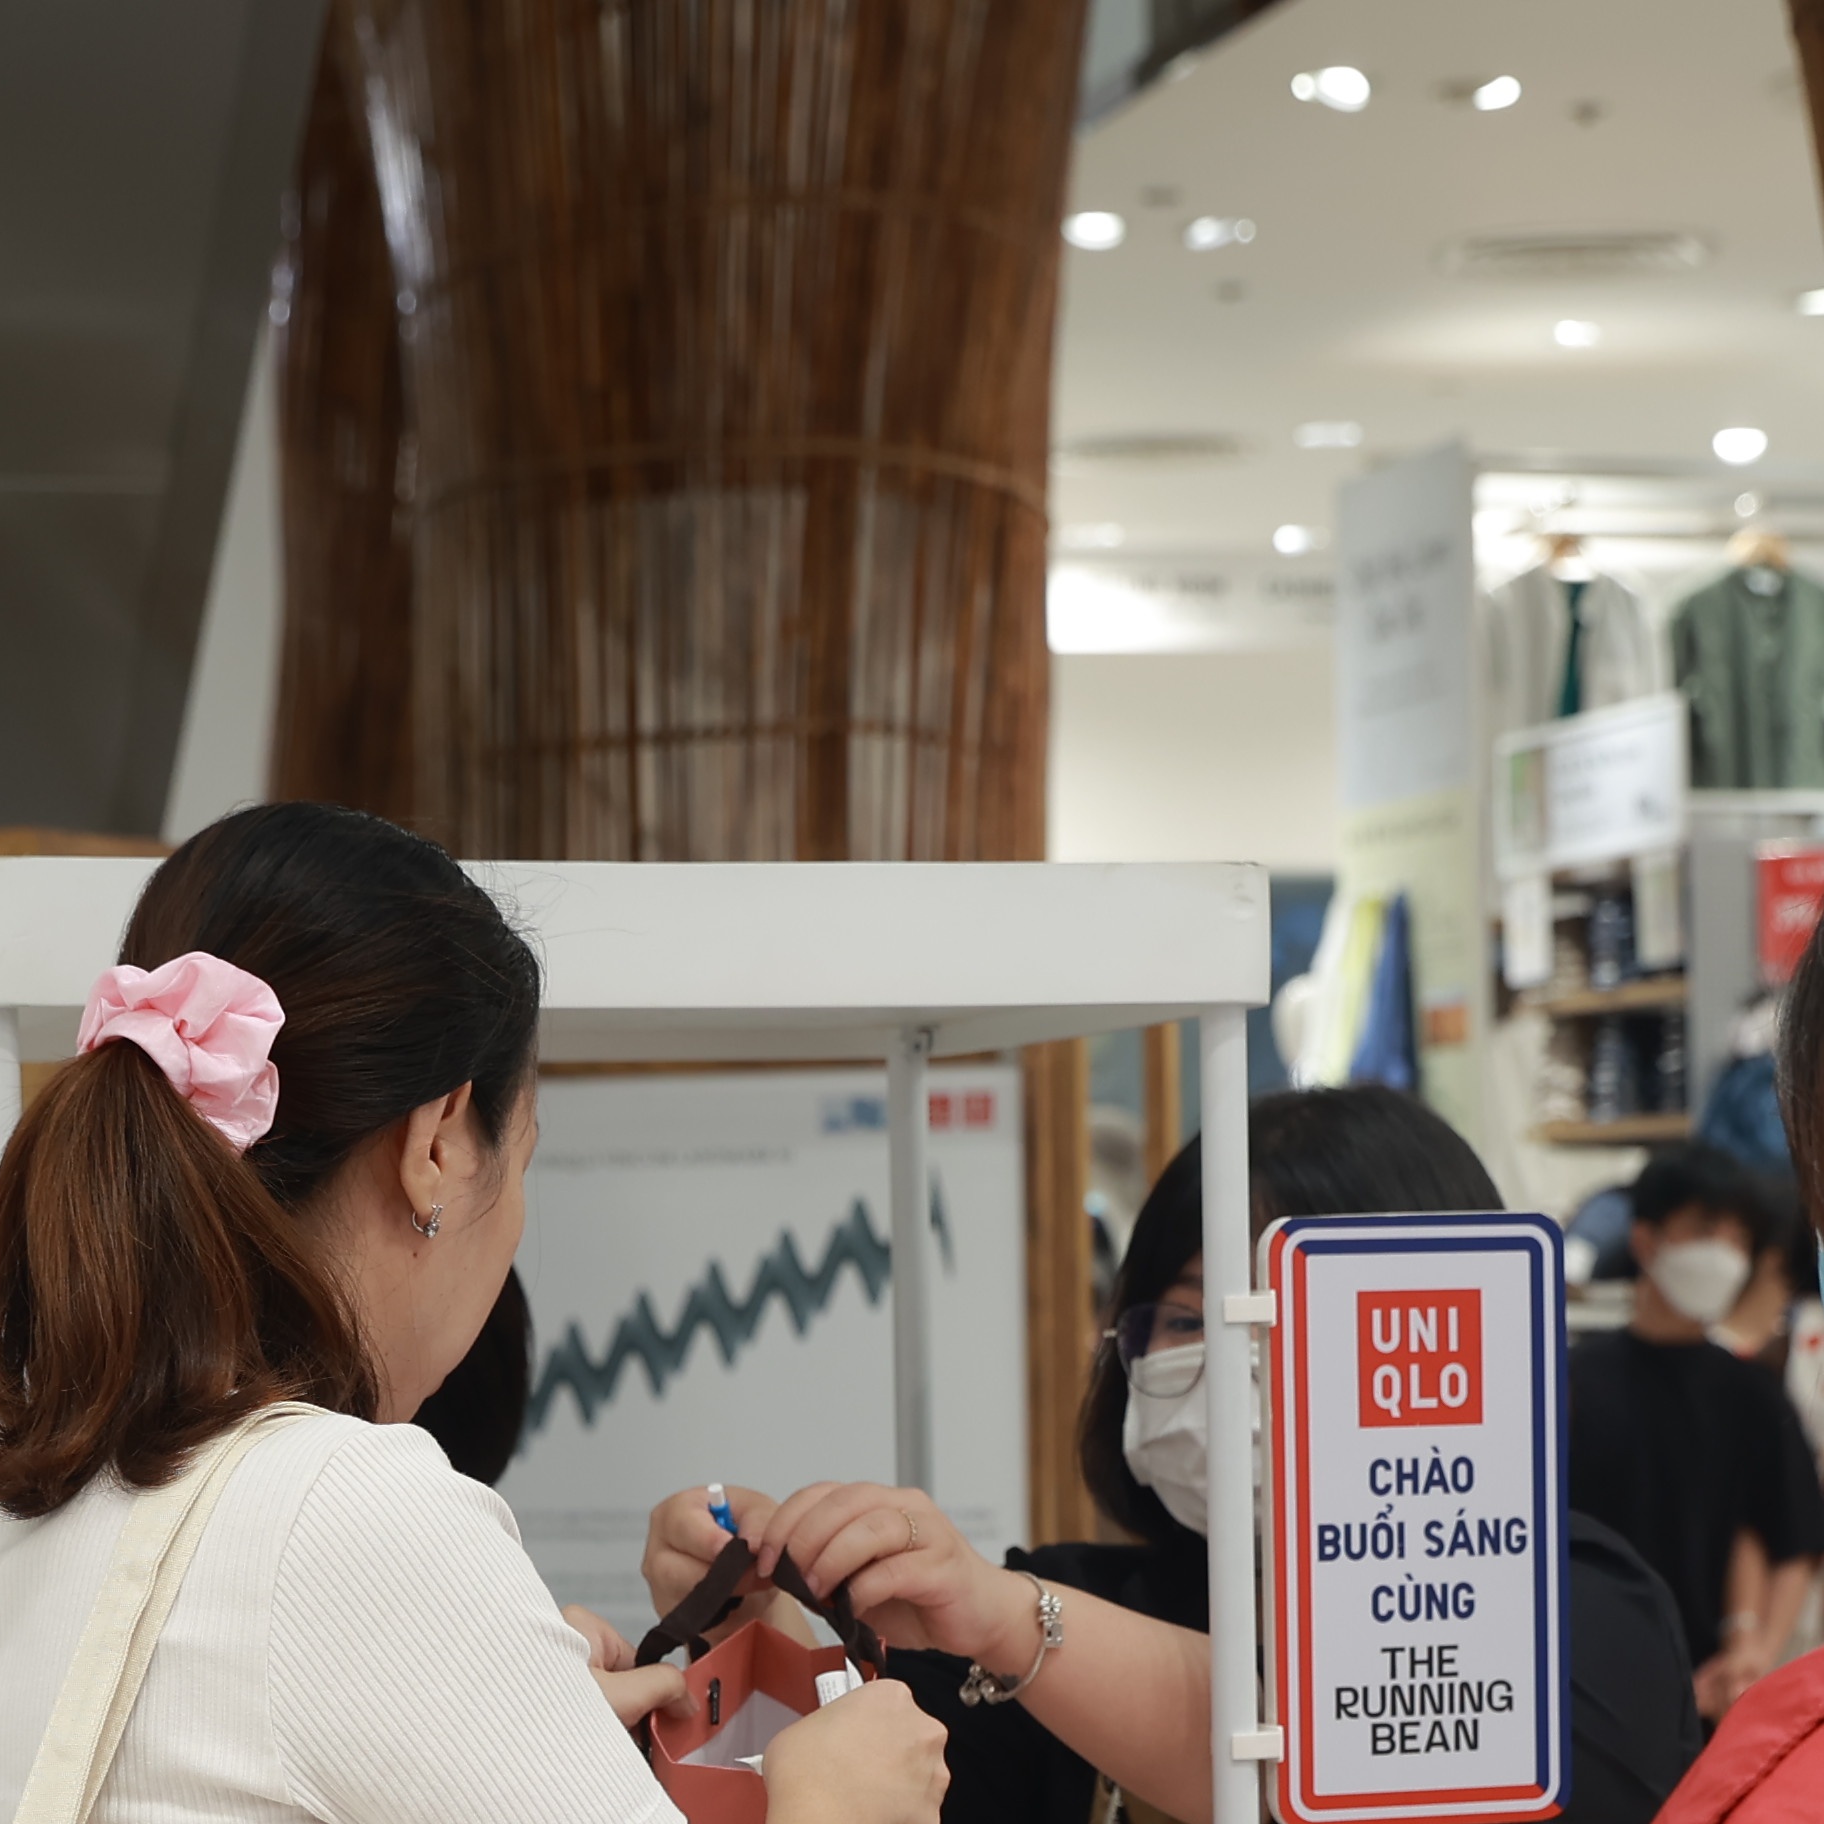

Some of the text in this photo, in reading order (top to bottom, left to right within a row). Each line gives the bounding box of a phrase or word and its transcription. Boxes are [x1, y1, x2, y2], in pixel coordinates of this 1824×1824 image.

[1371, 1306, 1459, 1354] UNI
[1372, 1362, 1469, 1419] QLO
[1369, 1445, 1474, 1497] CHÀO
[1317, 1503, 1528, 1562] BUỔI SÁNG
[1371, 1573, 1475, 1623] CÙNG
[1380, 1644, 1459, 1680] THE
[1335, 1679, 1514, 1720] RUNNING
[1371, 1718, 1479, 1756] BEAN
